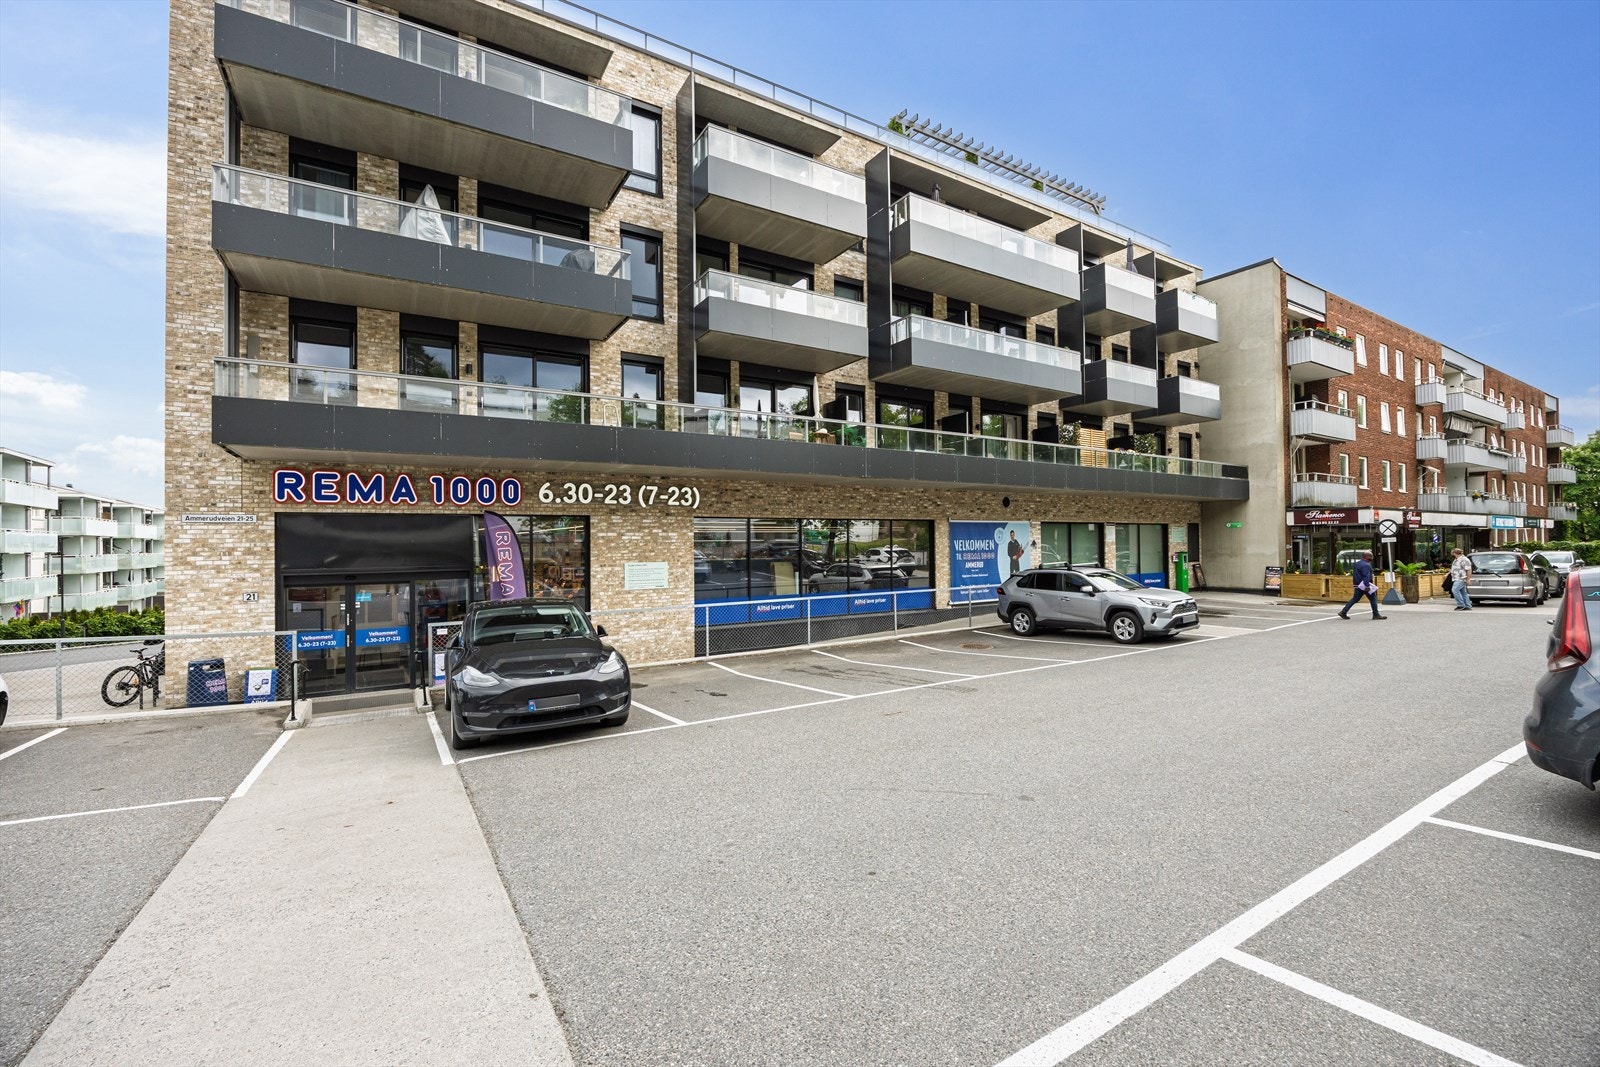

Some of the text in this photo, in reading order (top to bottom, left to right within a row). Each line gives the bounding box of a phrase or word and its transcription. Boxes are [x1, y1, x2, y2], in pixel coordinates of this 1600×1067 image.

[273, 469, 522, 506] REMA 1000
[538, 482, 701, 509] 6.30-23 (7-23)
[954, 539, 994, 550] VELKOMMEN
[495, 531, 515, 596] REMA
[246, 593, 256, 601] 21
